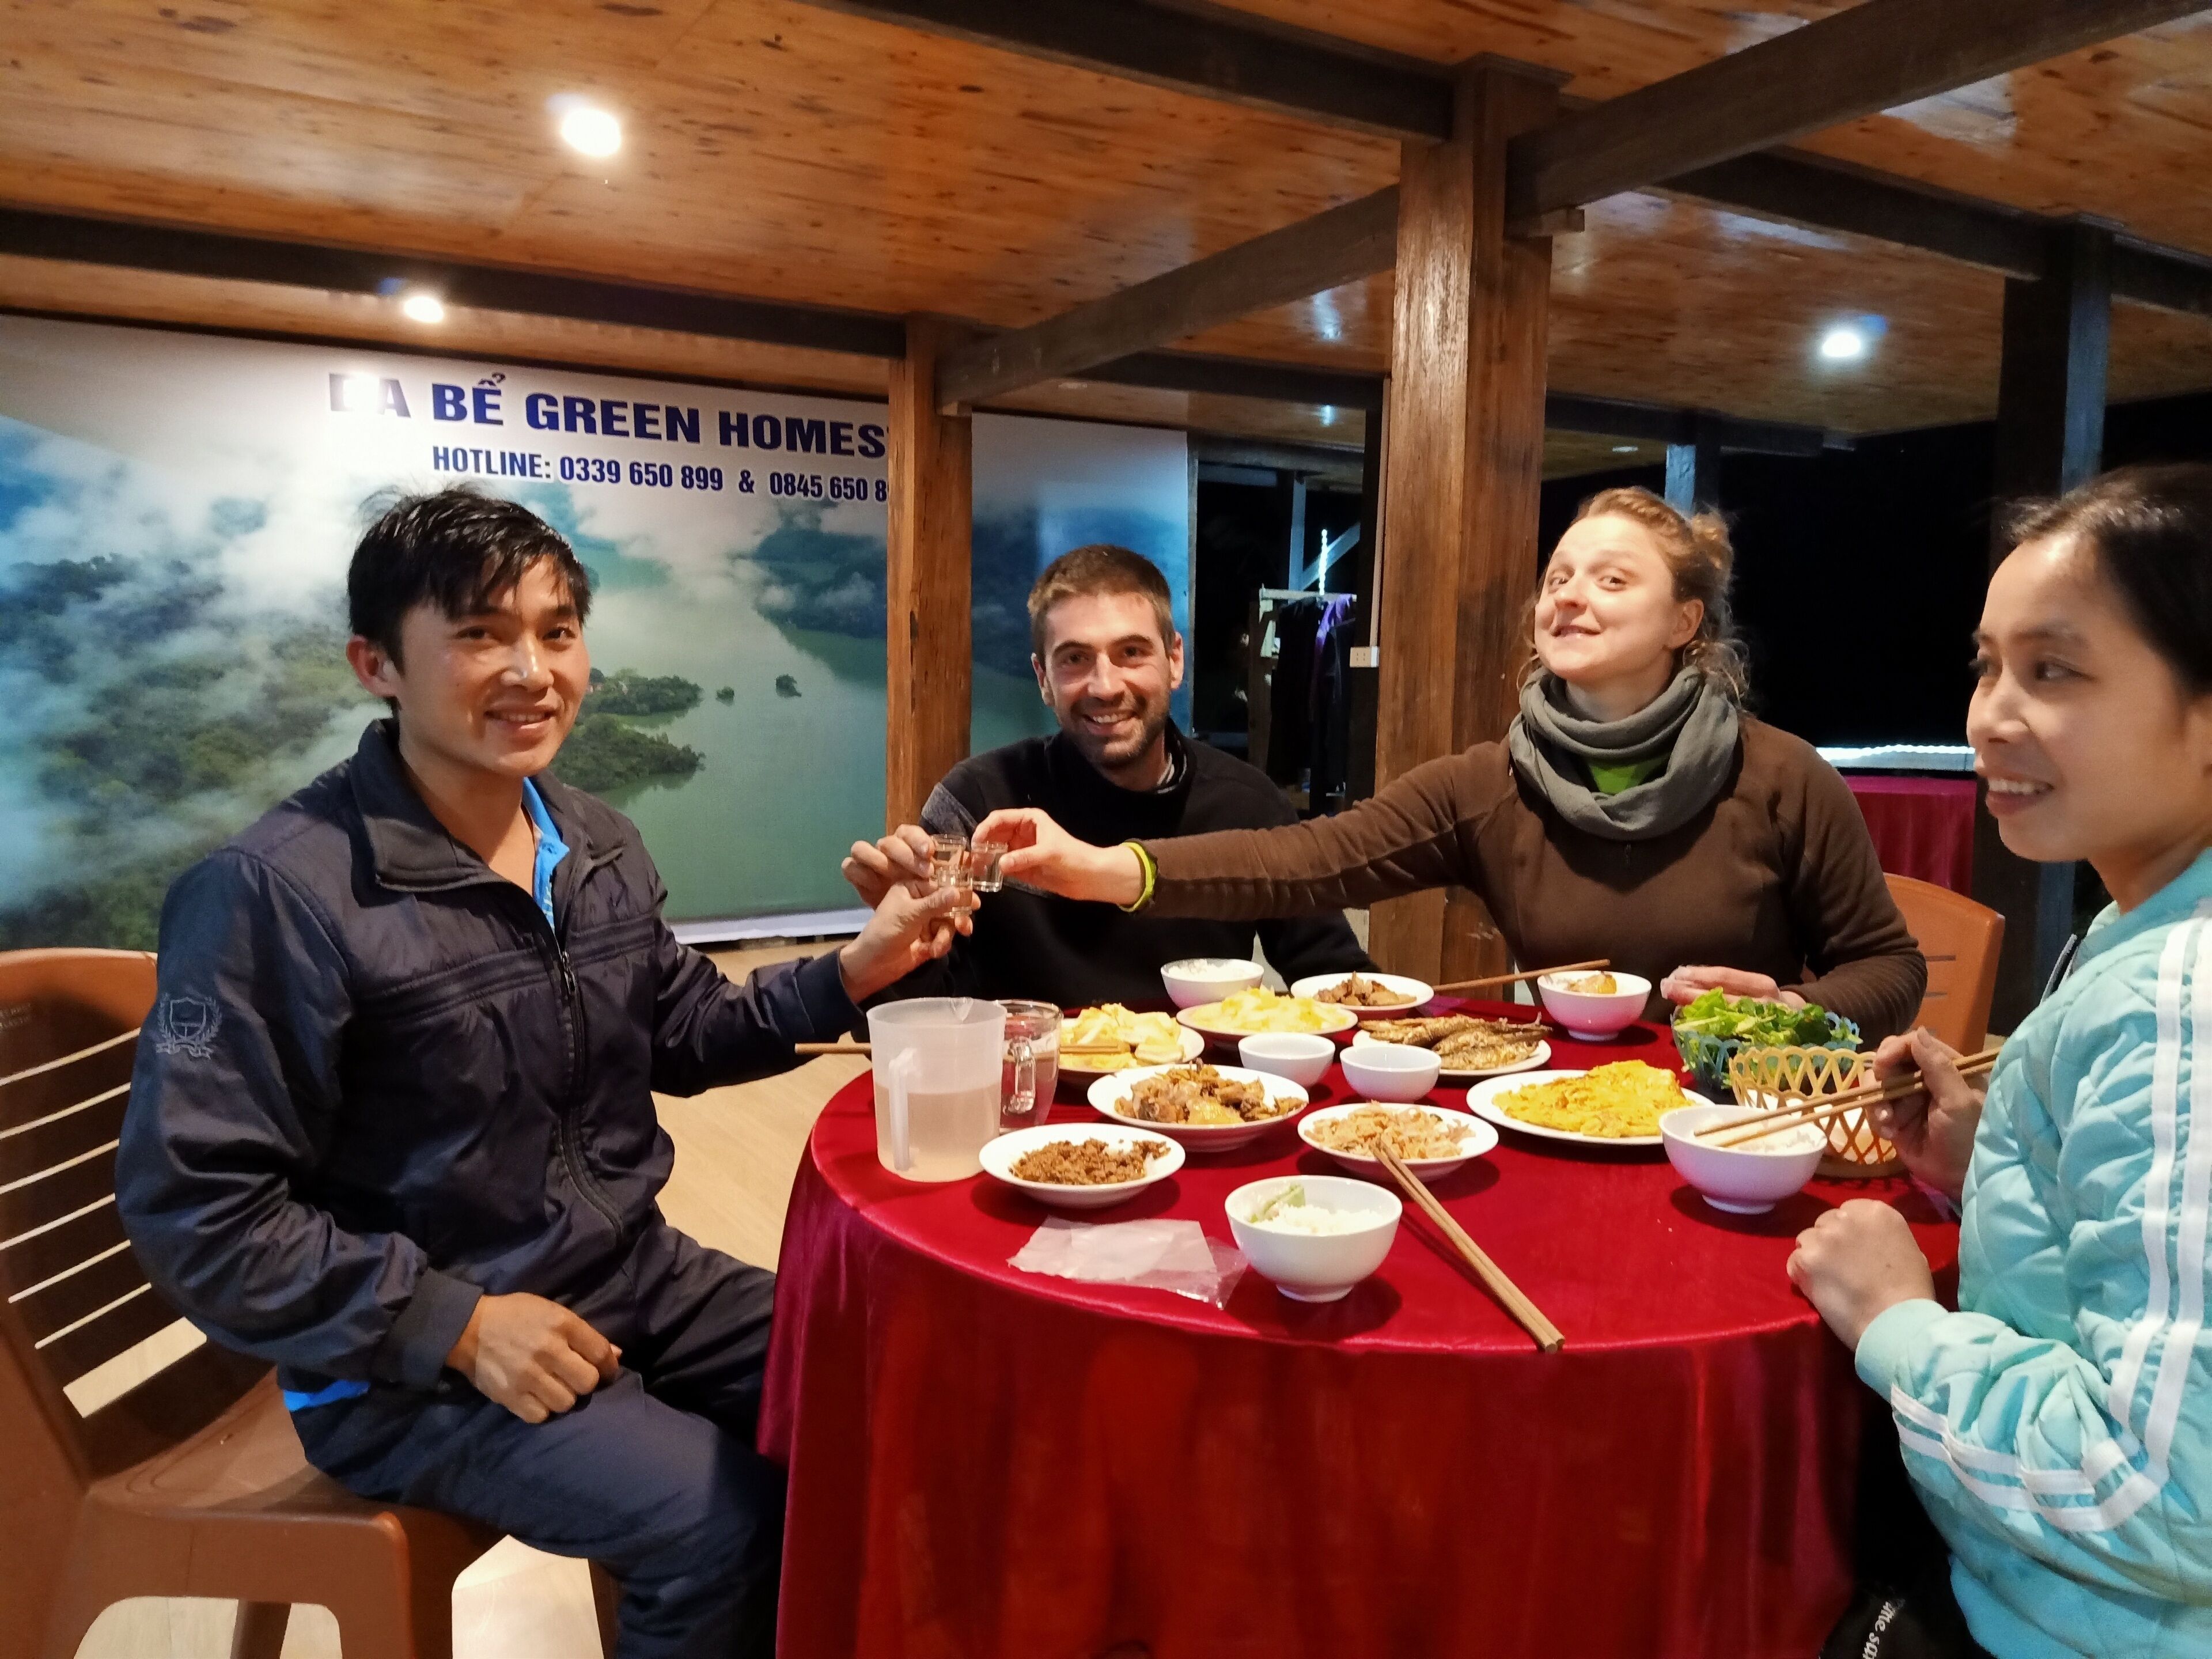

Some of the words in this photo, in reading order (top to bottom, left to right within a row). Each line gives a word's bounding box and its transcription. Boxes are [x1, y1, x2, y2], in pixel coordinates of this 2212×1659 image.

[431, 372, 506, 426] BỂ
[525, 392, 701, 444] GREEN
[718, 410, 889, 459] HOMES
[433, 446, 551, 479] HOTLINE:
[559, 456, 620, 484] 0339
[628, 461, 673, 488] 650
[680, 465, 724, 491] 899
[738, 469, 755, 494] &
[769, 471, 824, 499] 0845
[828, 475, 868, 501] 650
[874, 479, 889, 502] 8
